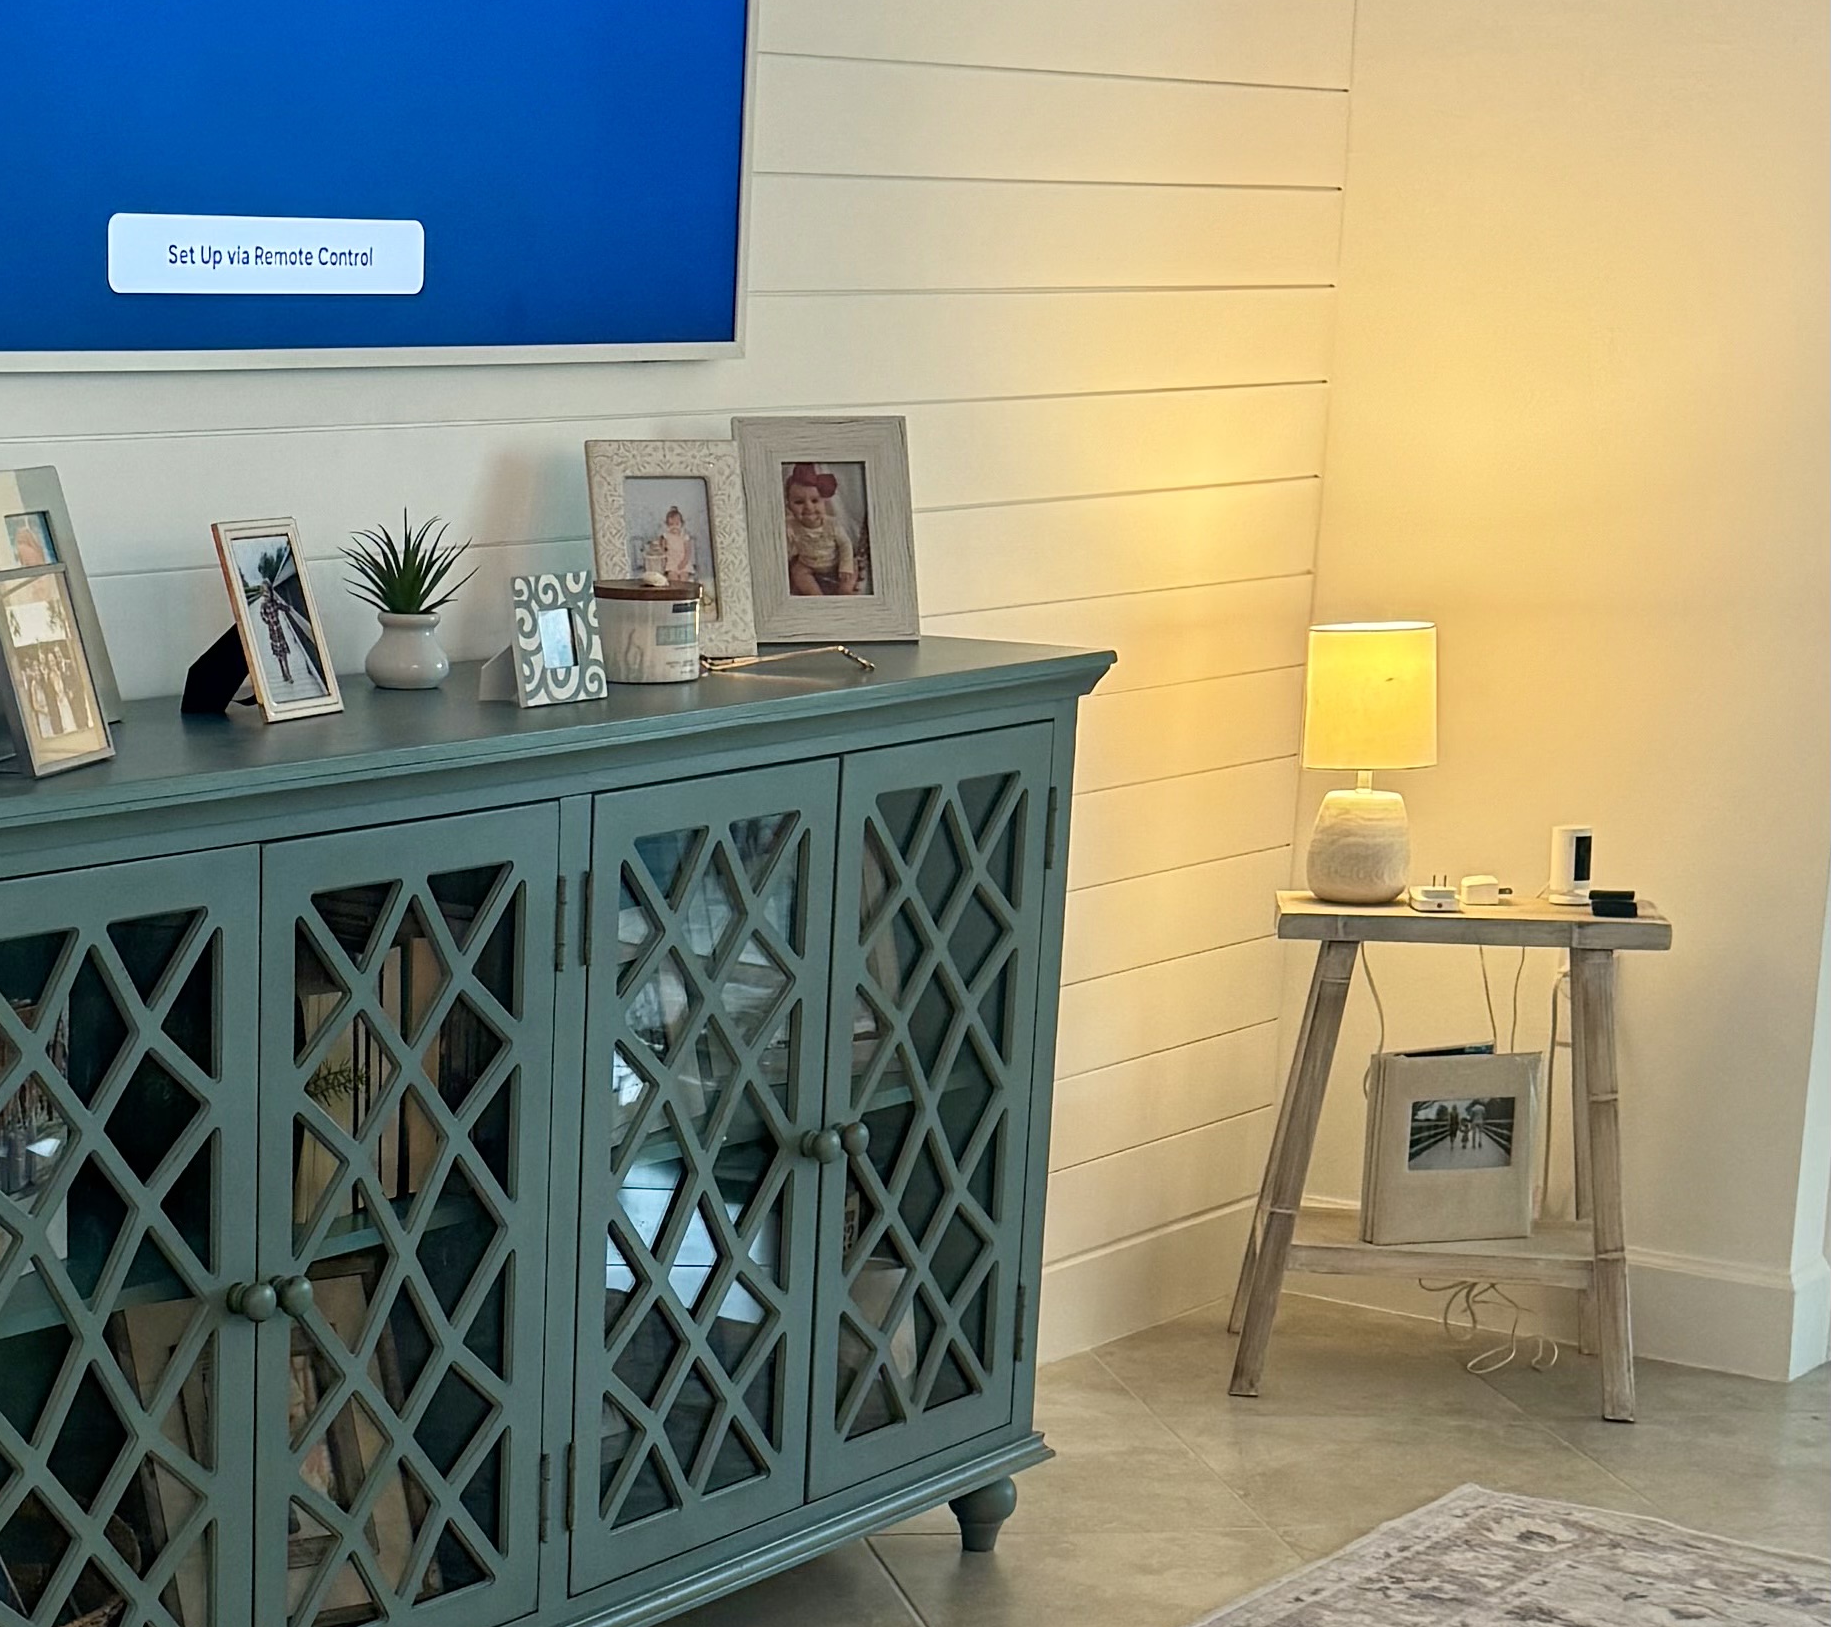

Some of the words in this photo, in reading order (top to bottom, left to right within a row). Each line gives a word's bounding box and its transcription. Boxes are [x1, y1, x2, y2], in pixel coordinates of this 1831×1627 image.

[168, 244, 196, 265] Set
[200, 245, 223, 270] Up
[227, 245, 250, 265] via
[254, 245, 314, 266] Remote
[318, 246, 373, 267] Control
